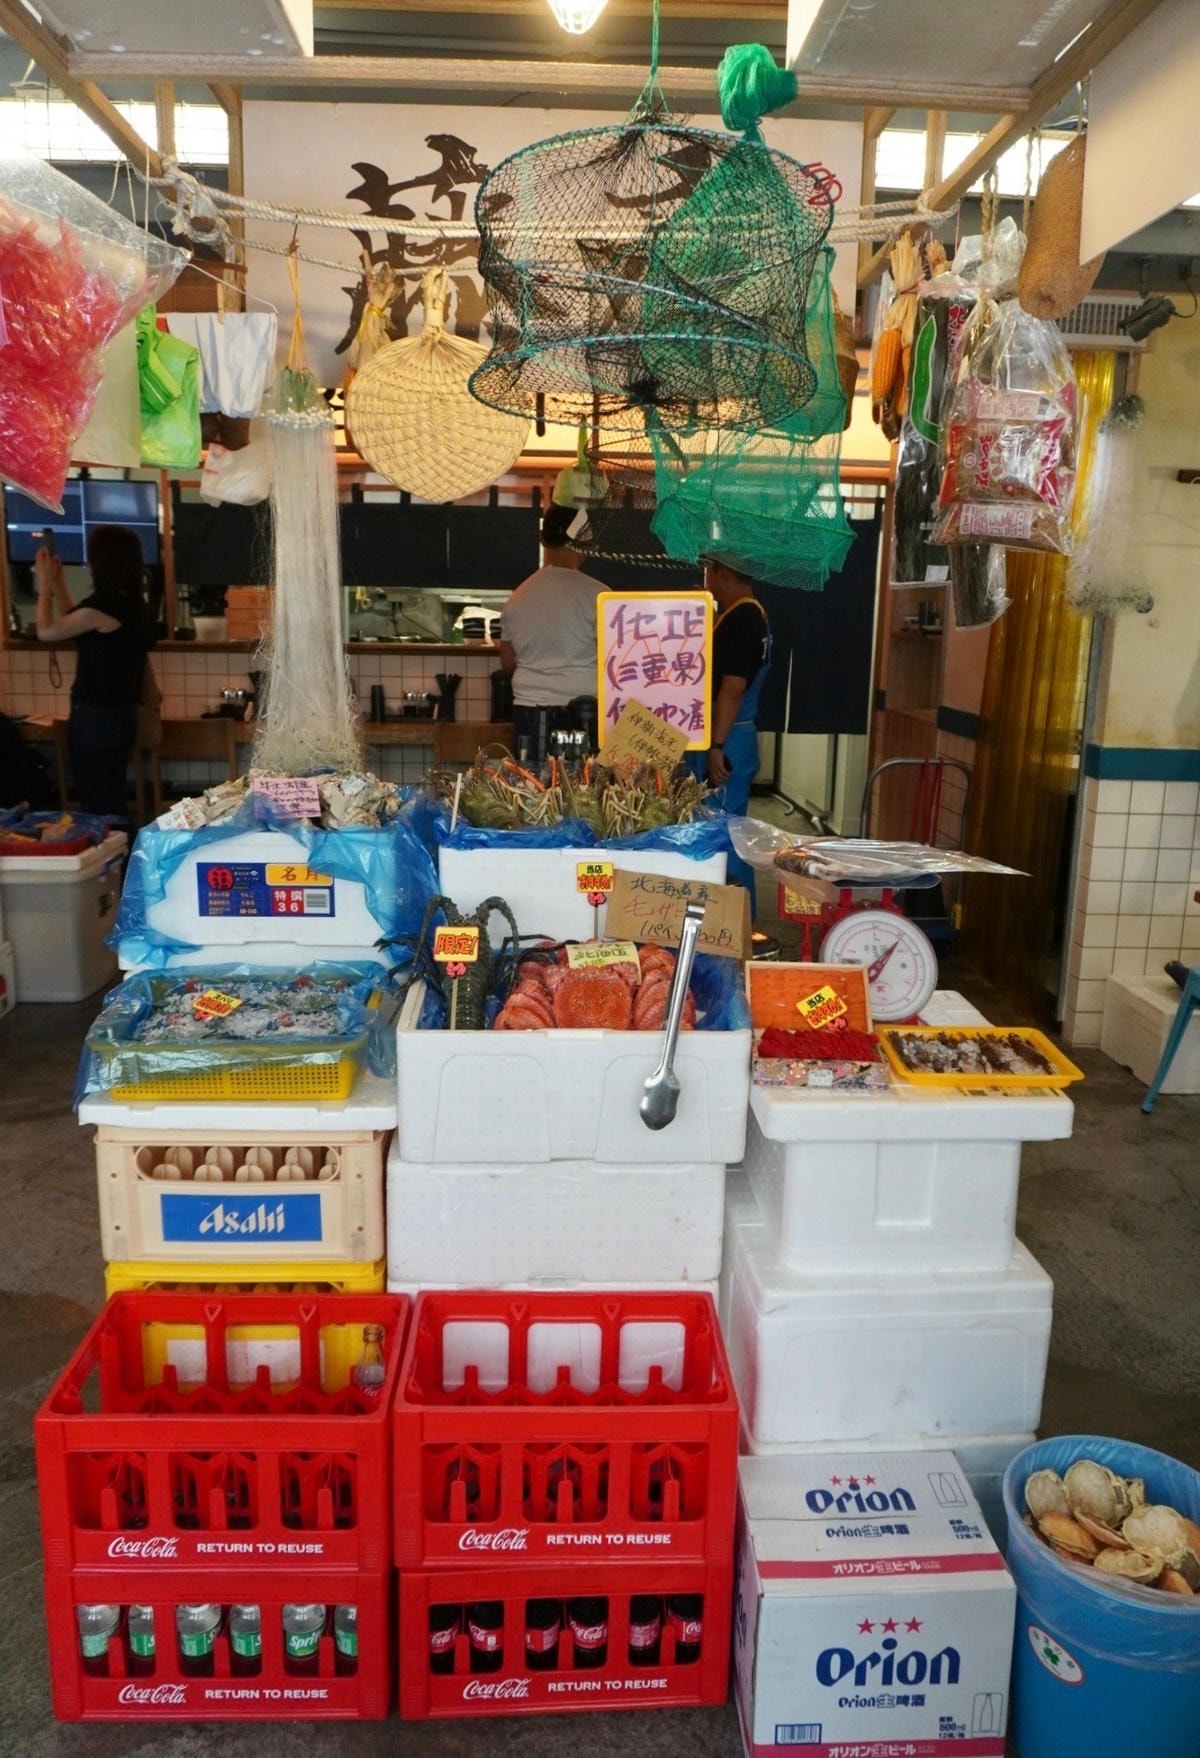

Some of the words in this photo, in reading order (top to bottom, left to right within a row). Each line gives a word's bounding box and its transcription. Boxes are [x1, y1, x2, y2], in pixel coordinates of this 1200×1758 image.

[434, 933, 478, 955] 限定!
[806, 992, 825, 1009] 当店
[199, 1202, 285, 1234] Asahi
[805, 1483, 917, 1514] Orion
[108, 1537, 180, 1558] Coca-Cola
[197, 1543, 252, 1554] RETURN
[256, 1543, 275, 1553] TO
[277, 1543, 323, 1554] REUSE
[458, 1529, 530, 1550] Coca-Cola
[547, 1534, 602, 1544] RETURN
[605, 1534, 624, 1544] TO
[626, 1533, 672, 1544] REUSE
[816, 1638, 960, 1687] Orion
[118, 1684, 189, 1704] Coca-Cola
[205, 1690, 260, 1699] RETURN
[263, 1690, 281, 1699] TO
[283, 1690, 328, 1699] REUSE
[462, 1678, 532, 1700] Coca-Cola
[548, 1682, 601, 1692] RETURN
[604, 1681, 622, 1690] TO
[624, 1679, 667, 1689] REUSE
